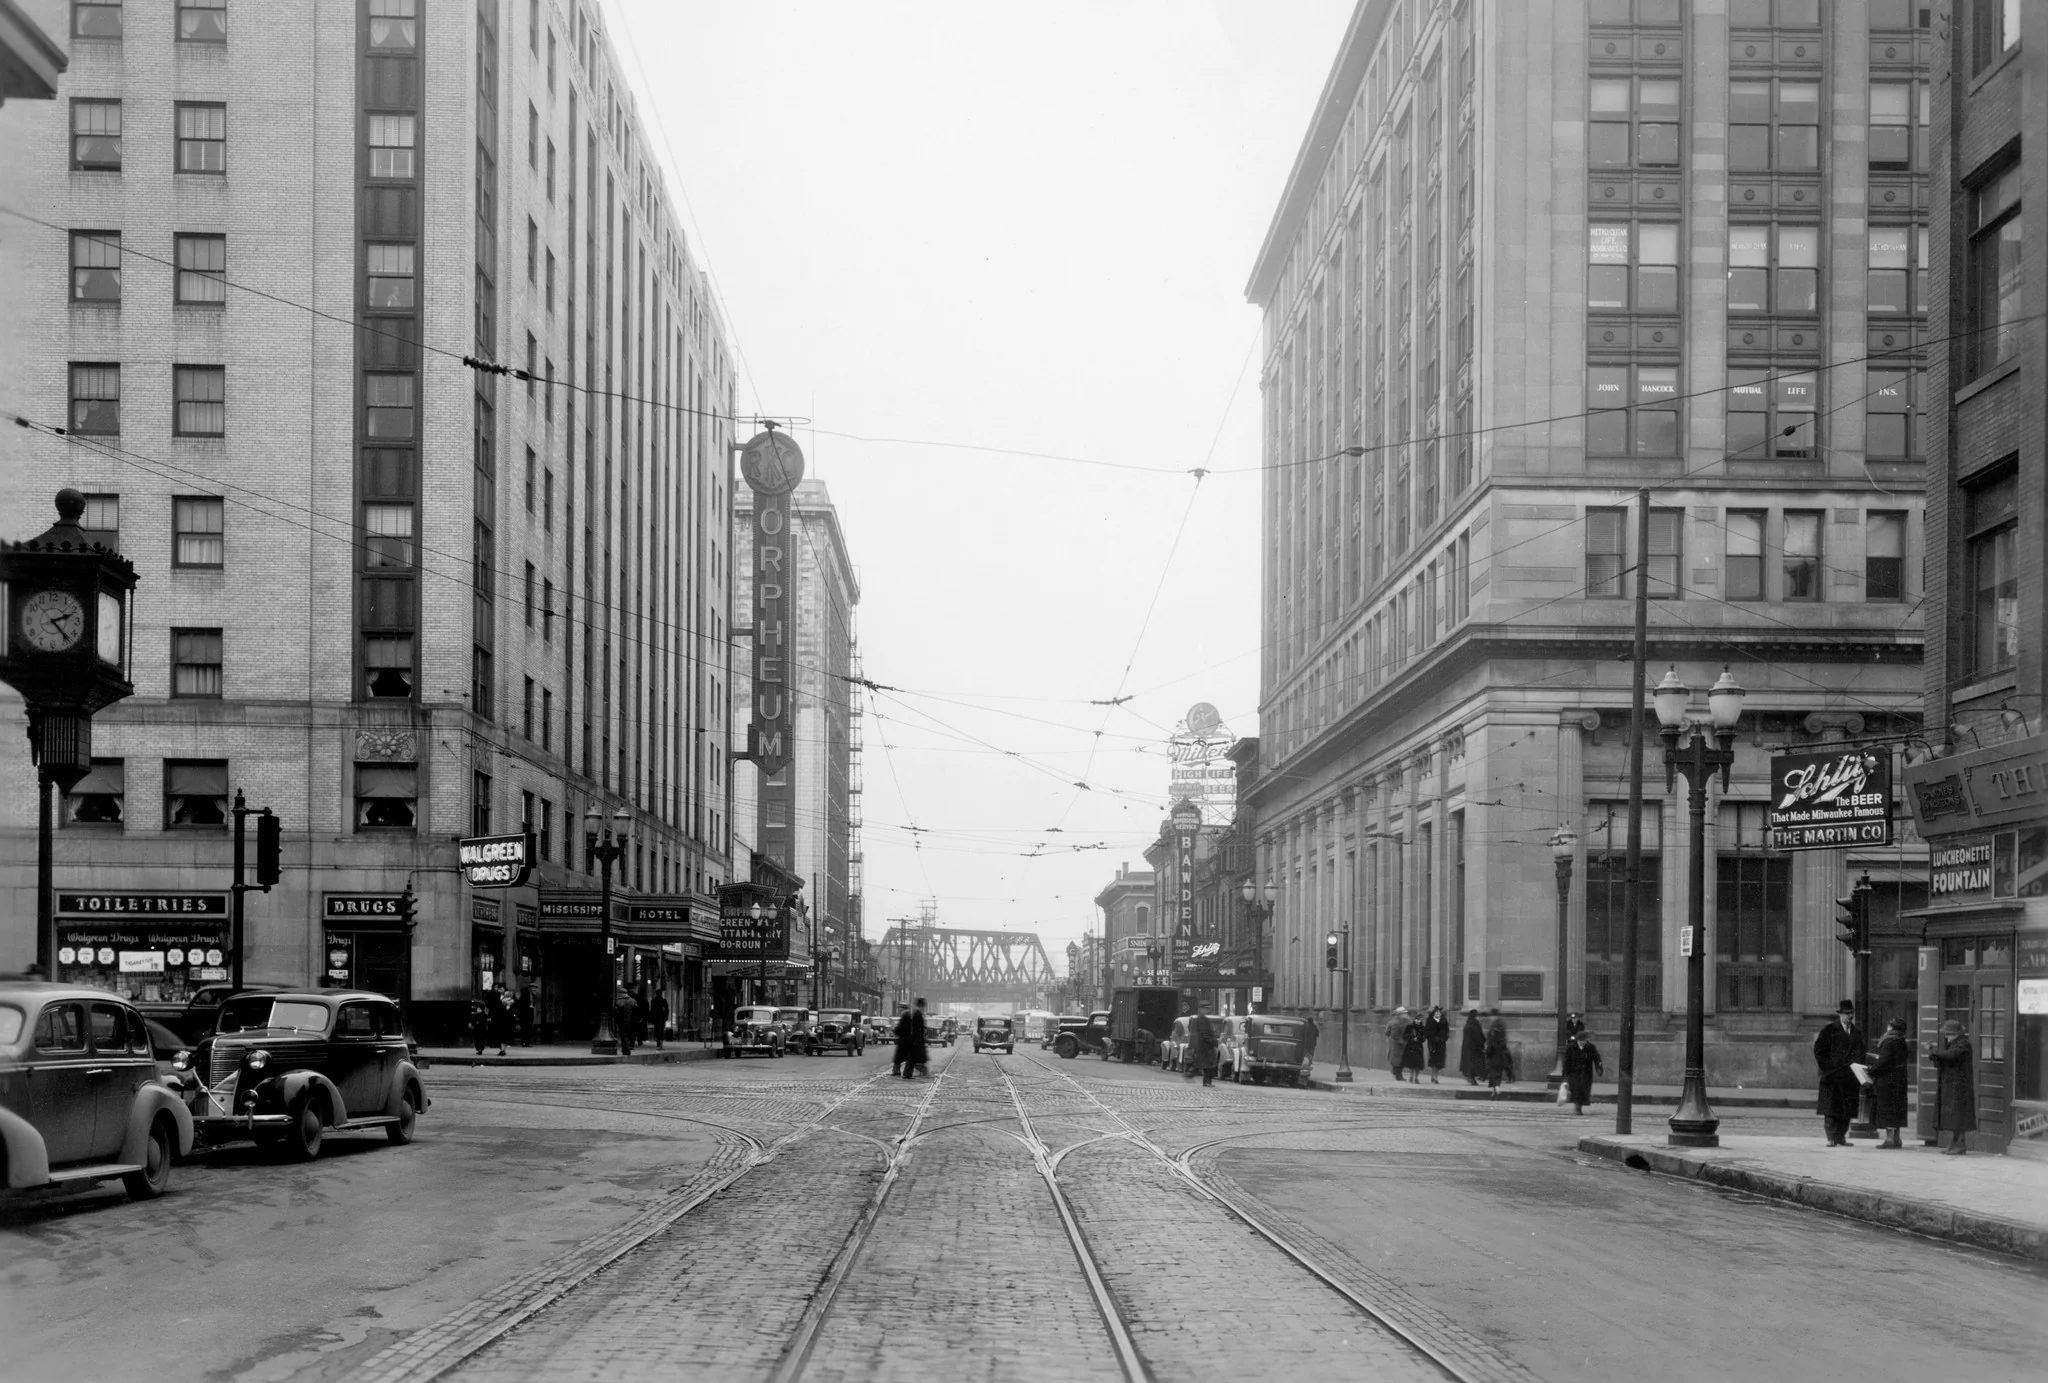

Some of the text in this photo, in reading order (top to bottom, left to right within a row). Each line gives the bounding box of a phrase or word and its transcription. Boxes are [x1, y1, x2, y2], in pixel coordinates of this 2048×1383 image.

[1596, 384, 1898, 396] JOHN HANCOCK MUTUAL LIFE INS.
[747, 443, 796, 487] RKO
[758, 507, 784, 758] ORPHEUM
[1174, 770, 1230, 779] HIGH LIFE
[1204, 785, 1233, 793] BEER
[1836, 793, 1882, 806] The BEER
[1772, 806, 1884, 822] That Made Milwaukee Famous
[1775, 825, 1882, 845] THE MARTIN CO
[460, 841, 523, 864] WALGREEN
[1932, 845, 1990, 867] LUNCHEONETTE
[472, 865, 510, 881] DRUGS
[1182, 836, 1192, 936] BAWDEN
[1932, 868, 1990, 892] FOUNTAIN
[76, 898, 208, 911] TOILETRIES
[334, 901, 396, 913] DRUGS
[543, 905, 603, 915] MISSISSIPP
[639, 910, 680, 919] HOTEL
[67, 932, 140, 945] Walgreen Drugs
[148, 933, 220, 945] Walgreen Drugs
[327, 934, 352, 947] Drugs
